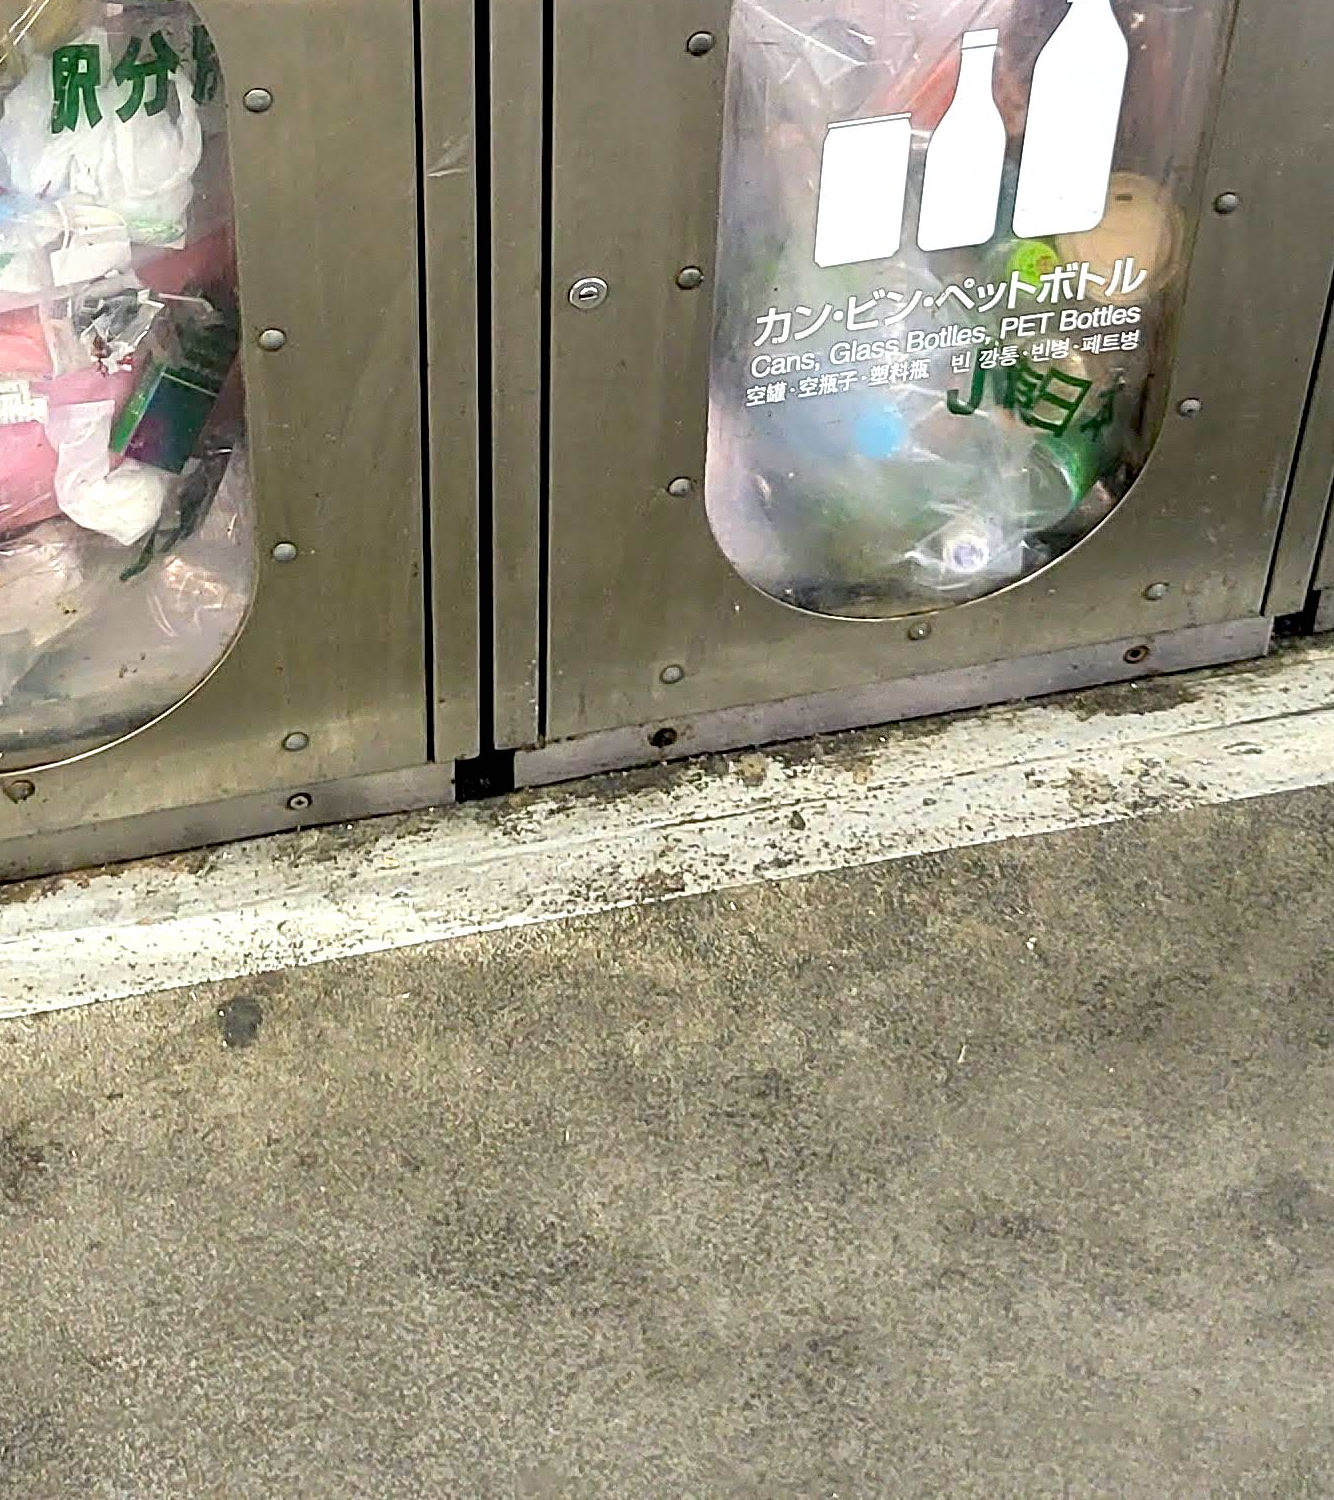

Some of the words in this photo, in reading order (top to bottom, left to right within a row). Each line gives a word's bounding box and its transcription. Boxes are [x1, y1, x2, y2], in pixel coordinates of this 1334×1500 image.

[750, 351, 821, 379] Cans,
[829, 339, 900, 365] Glass
[999, 311, 1055, 340] PET
[1058, 304, 1142, 331] Bottles
[753, 257, 1148, 347] カン・ビン・ペットボトル
